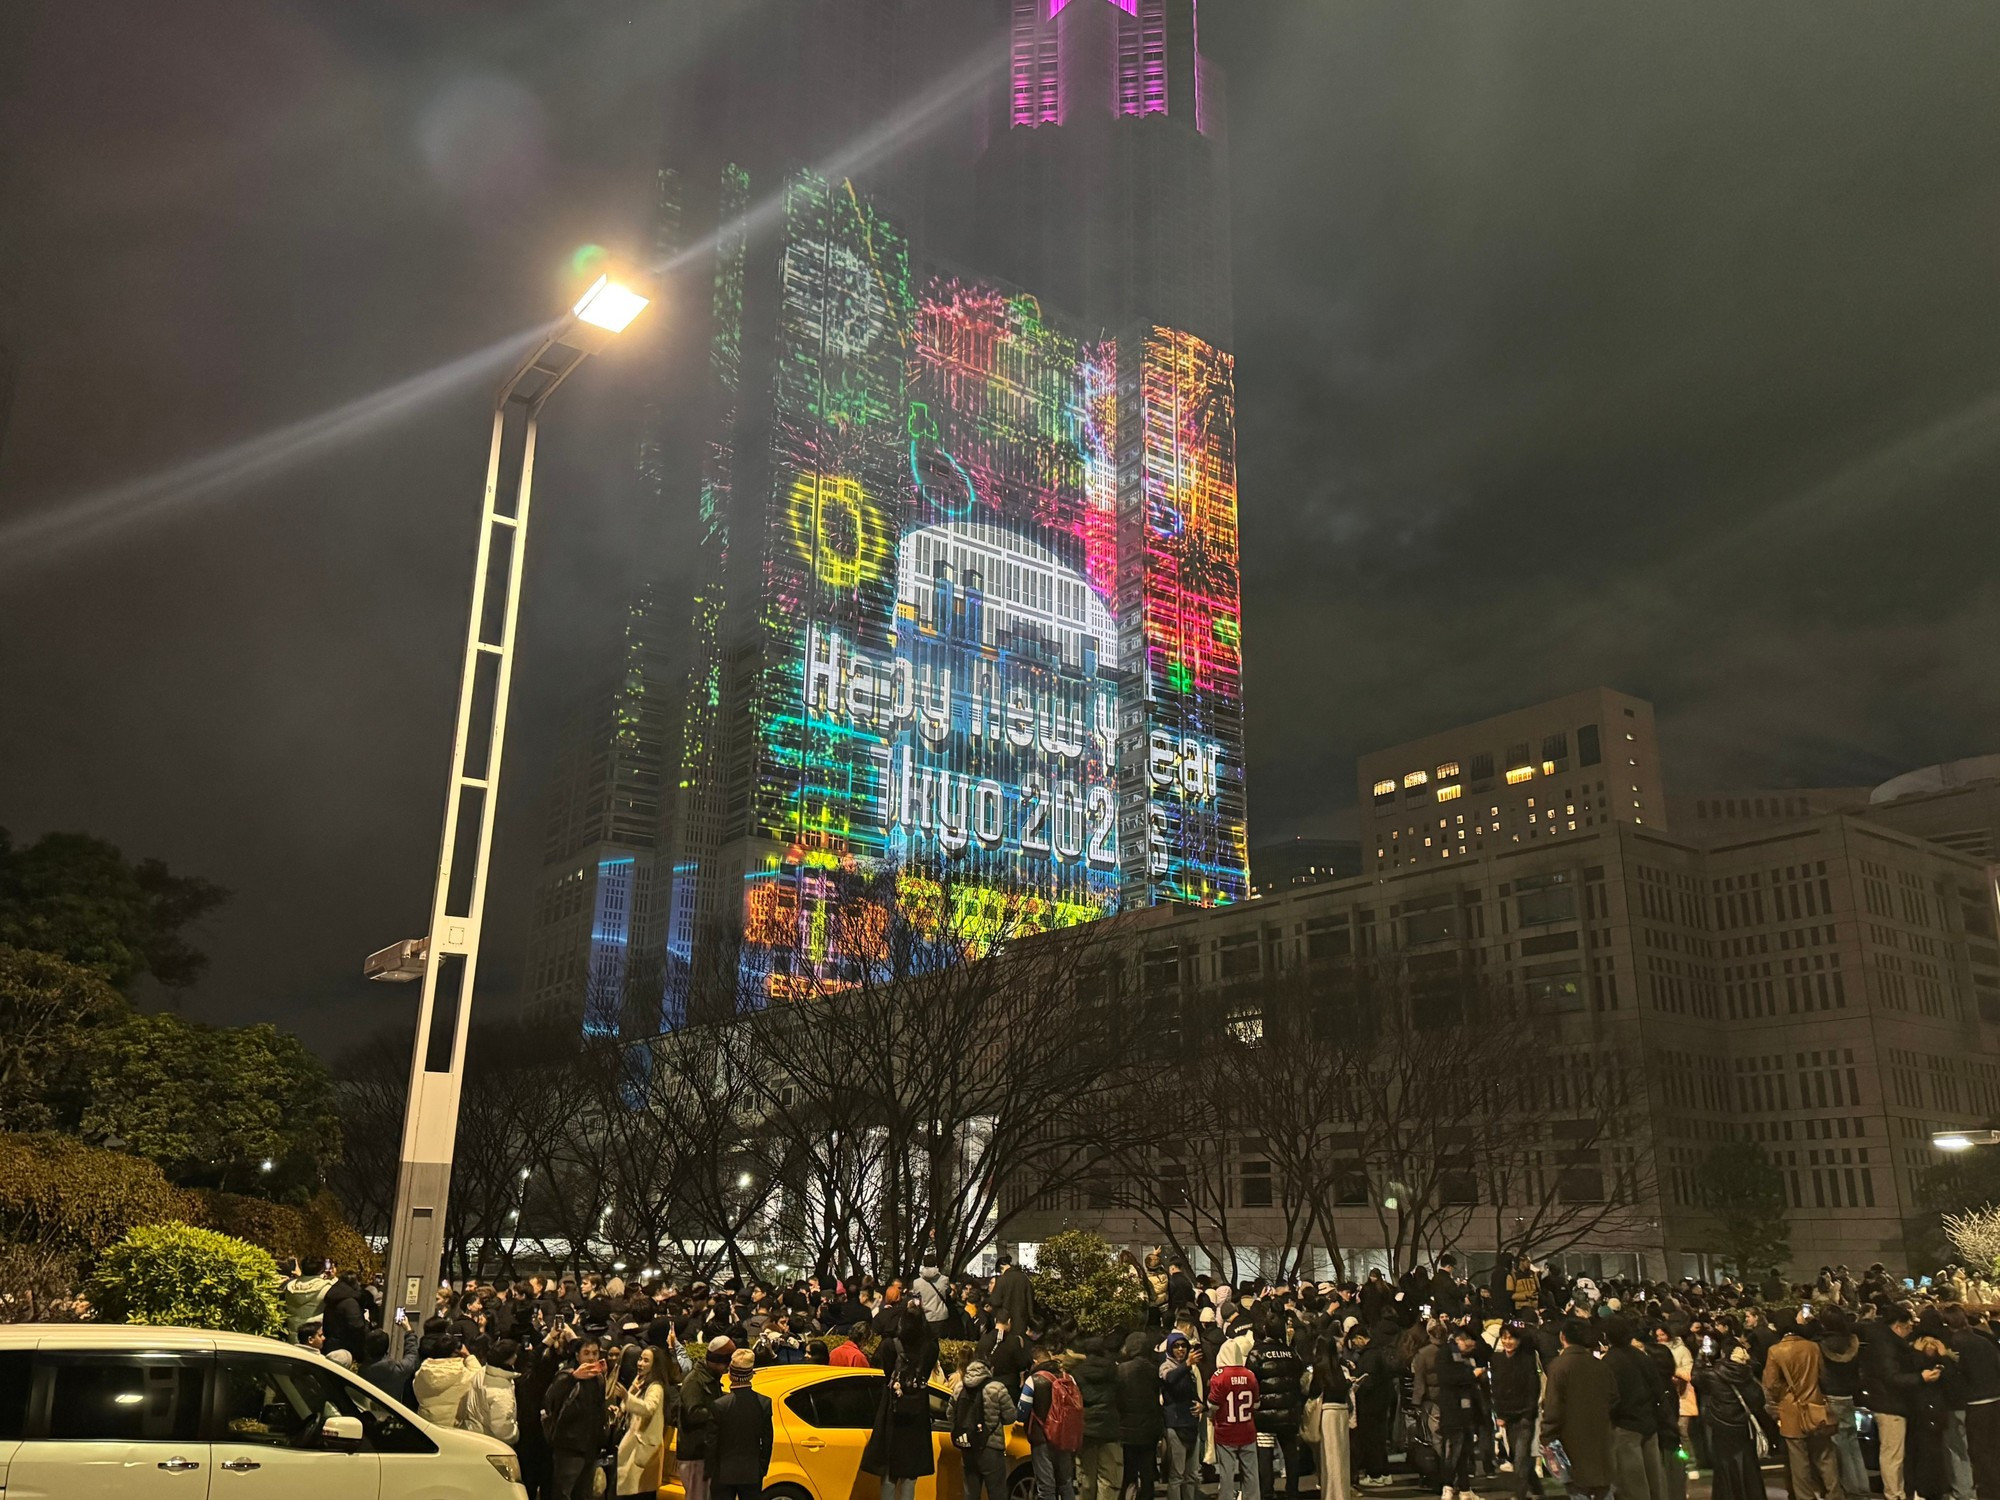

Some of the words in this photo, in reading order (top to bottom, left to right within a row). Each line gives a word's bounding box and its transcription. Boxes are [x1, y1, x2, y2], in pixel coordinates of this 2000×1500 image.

[1265, 1350, 1293, 1359] CELINE
[1230, 1376, 1248, 1386] BRADY
[1226, 1390, 1253, 1423] 12
